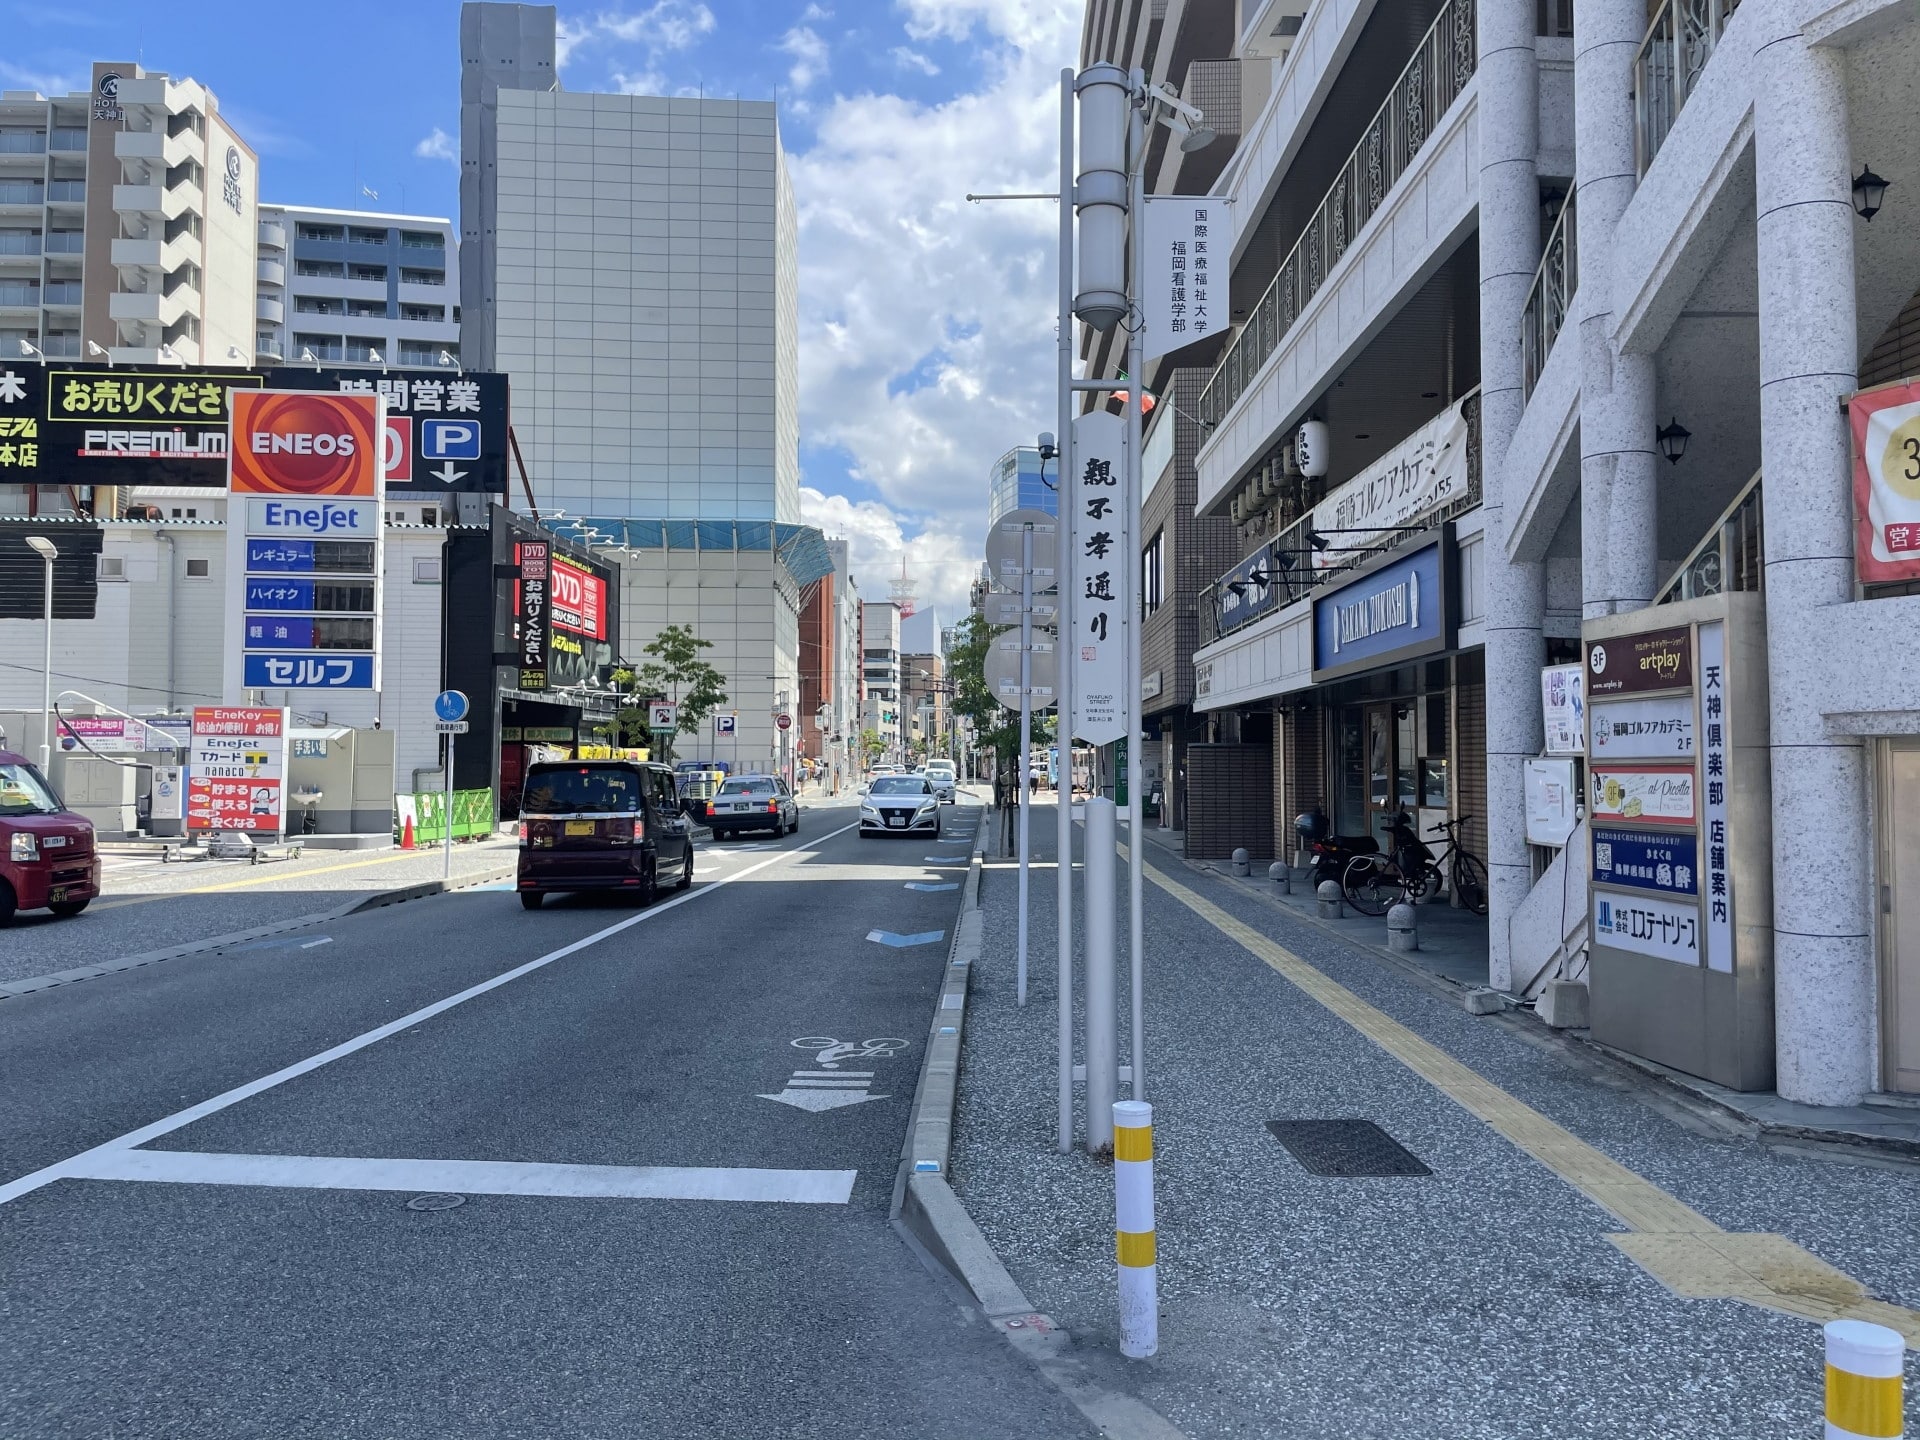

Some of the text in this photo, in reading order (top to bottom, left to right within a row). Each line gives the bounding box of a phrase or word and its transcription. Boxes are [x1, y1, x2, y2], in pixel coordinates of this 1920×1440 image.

[1194, 209, 1208, 333] 国際医療福祉大学
[1171, 240, 1187, 333] 福岡看護学部
[252, 432, 355, 457] ENEOS
[0, 443, 38, 468] 本店
[252, 549, 310, 562] レギュラー
[525, 545, 545, 557] DVD
[1083, 457, 1117, 641] 親不孝通り
[251, 588, 299, 600] ハイオク
[584, 592, 596, 602] TOY
[1341, 582, 1407, 644] SAKANA ZUKUSHI
[525, 579, 543, 665] お売りください
[1593, 652, 1604, 667] 3F
[1640, 649, 1681, 674] artplay
[265, 658, 353, 685] セルフ
[522, 679, 544, 687] 福岡本店
[214, 710, 261, 720] EneKey
[1613, 719, 1691, 737] 福岡ゴルフアカデミー
[205, 767, 244, 776] nanaco
[212, 784, 249, 795] 貯まる
[1608, 787, 1617, 801] 3F
[212, 800, 248, 811] 使える
[211, 818, 257, 829] 安くなる
[1710, 819, 1727, 924] 店舗案内
[1615, 908, 1628, 921] 株式
[1615, 921, 1628, 933] 会社
[1630, 908, 1697, 950] エステートリース
